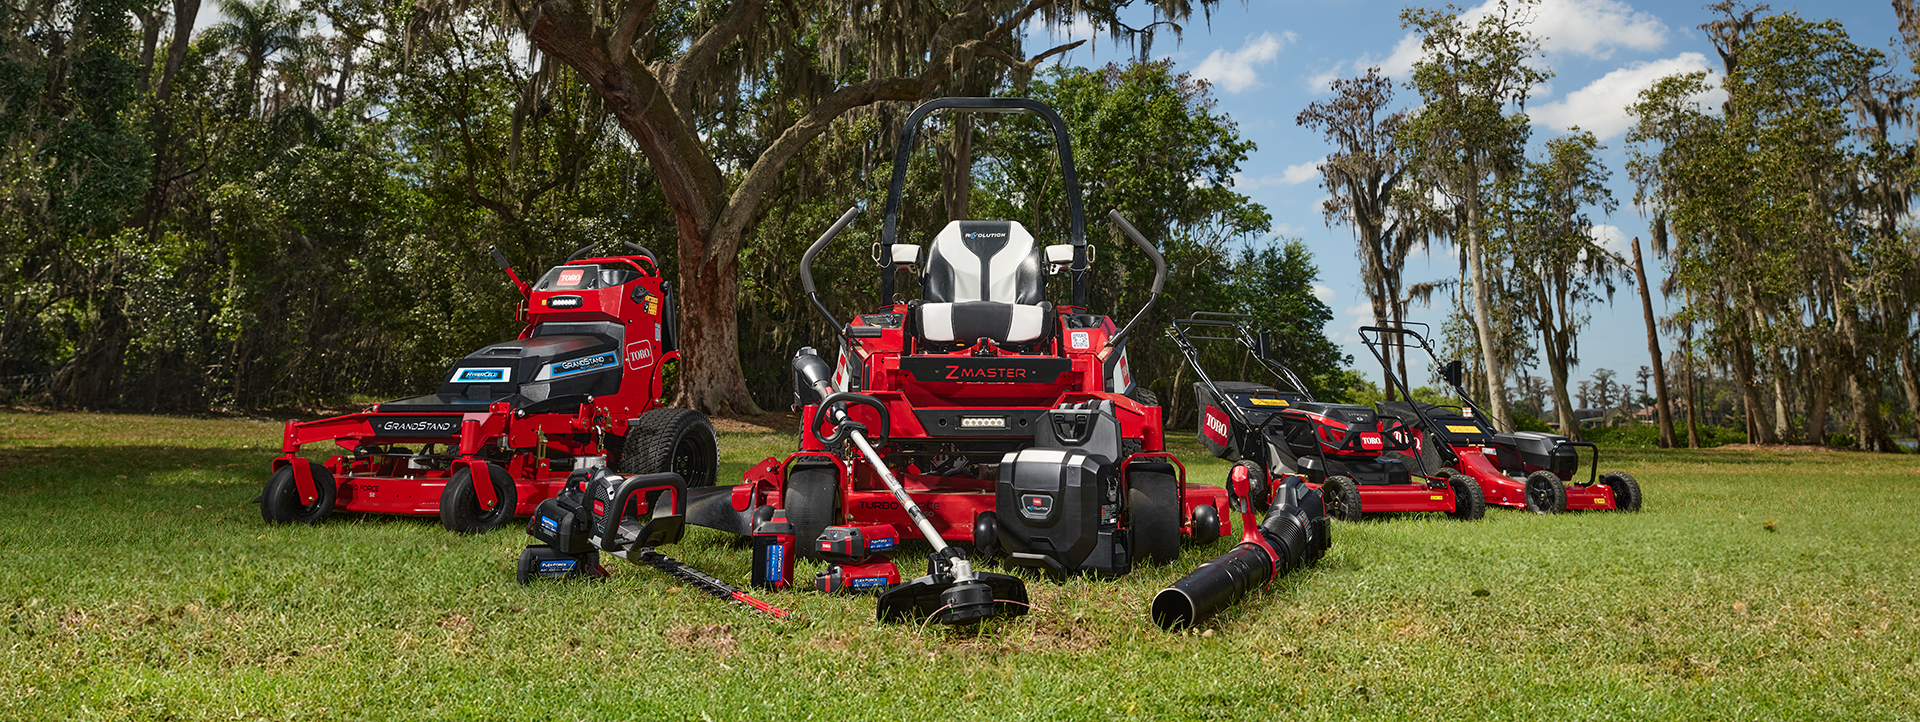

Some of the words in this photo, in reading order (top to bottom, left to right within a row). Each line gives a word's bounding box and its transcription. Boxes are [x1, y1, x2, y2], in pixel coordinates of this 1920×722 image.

[630, 348, 651, 362] TORO
[945, 365, 959, 379] Z
[961, 368, 1026, 378] MASTER
[383, 421, 451, 431] GRANDSTAND
[1206, 412, 1228, 438] TORO
[1361, 436, 1382, 445] TORO
[360, 484, 380, 493] FORCE
[860, 501, 899, 510] TURBO
